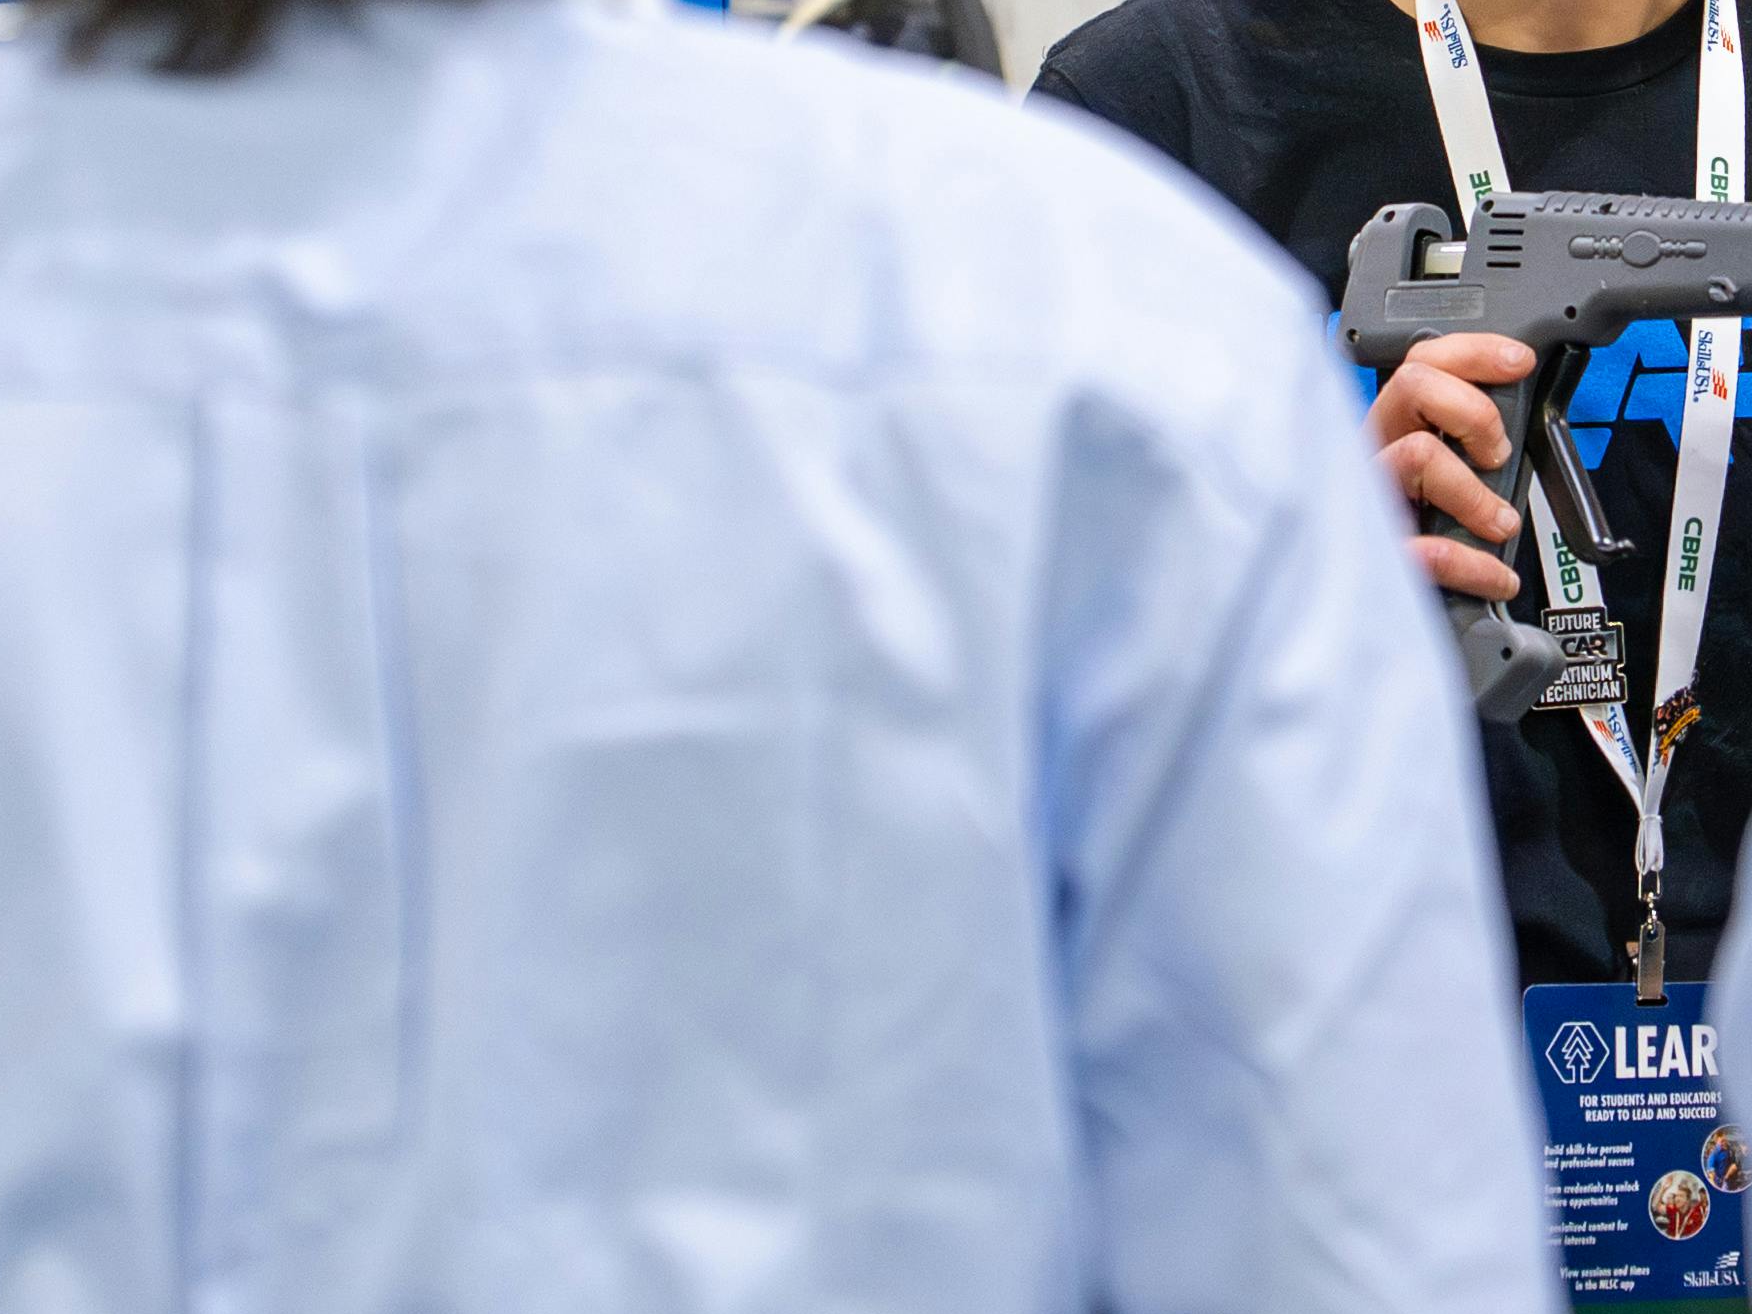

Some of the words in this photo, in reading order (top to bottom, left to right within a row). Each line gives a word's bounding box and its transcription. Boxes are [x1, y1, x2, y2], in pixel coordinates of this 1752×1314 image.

[1693, 329, 1714, 398] SkillsUSA
[1676, 516, 1704, 592] CBRE
[1547, 612, 1602, 632] FUTURE
[1580, 1094, 1599, 1108] FOR
[1601, 1094, 1646, 1107] STUDENTS
[1648, 1093, 1668, 1106] AND
[1670, 1091, 1722, 1105] EDUCATORS
[1585, 1109, 1615, 1123] READY
[1617, 1109, 1630, 1121] TO
[1632, 1108, 1654, 1121] LEAD
[1656, 1108, 1677, 1120] AND
[1679, 1107, 1717, 1120] SUCCEED
